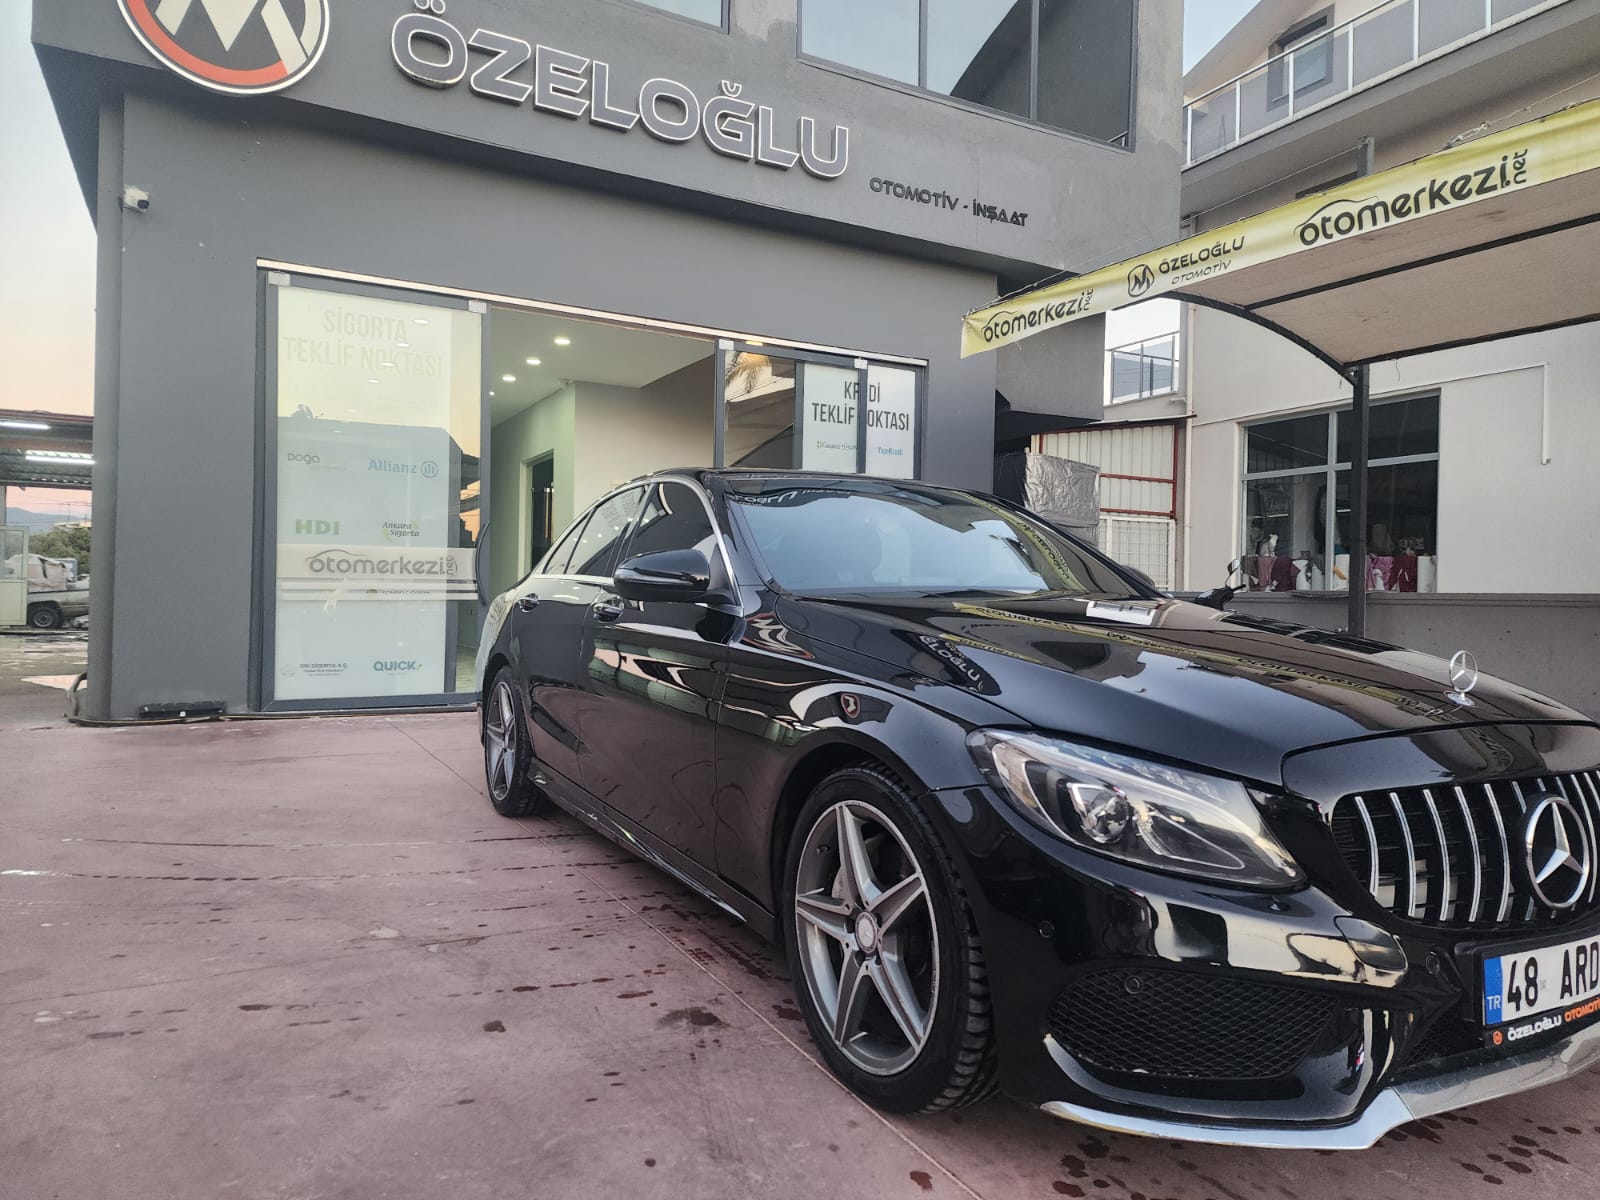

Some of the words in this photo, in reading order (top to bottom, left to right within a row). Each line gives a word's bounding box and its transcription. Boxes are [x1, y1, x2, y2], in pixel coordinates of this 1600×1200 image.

[391, 0, 849, 179] ÖZELOĞLU
[869, 177, 959, 210] OTOMOTİV
[973, 199, 1028, 226] İNŞAAT
[1158, 236, 1245, 275] ÖZELOĞLU
[1171, 260, 1232, 285] OTOMOTİV
[323, 307, 408, 343] SİGORTA
[844, 381, 880, 403] KRDİ
[812, 402, 856, 425] TEKLİF
[867, 409, 910, 432] OKTASI
[368, 459, 417, 474] Allianz
[295, 520, 340, 536] HDI
[373, 661, 416, 672] QUICK
[1507, 957, 1538, 1012] 48
[1486, 995, 1501, 1011] TR
[1507, 1015, 1562, 1042] ÖZELOĞLU
